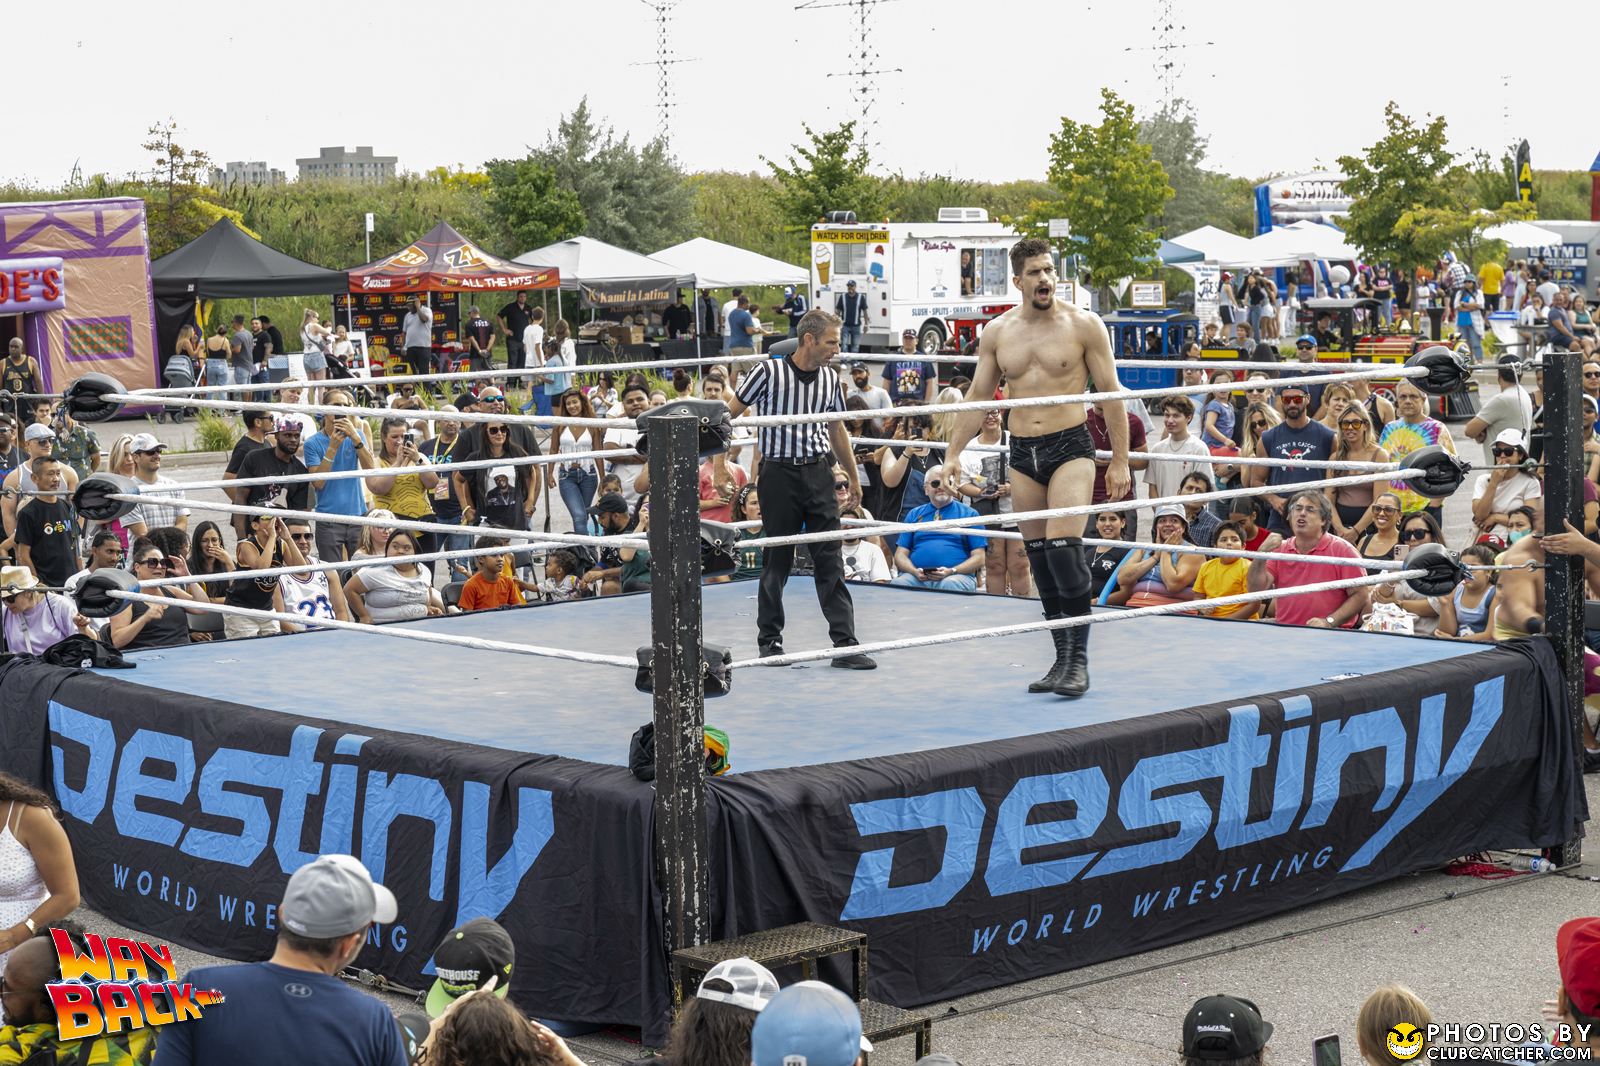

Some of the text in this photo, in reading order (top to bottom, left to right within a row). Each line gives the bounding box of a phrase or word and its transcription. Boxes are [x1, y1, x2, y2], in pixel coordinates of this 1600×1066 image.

[816, 232, 838, 240] WATCH
[856, 232, 887, 241] CHILDREN
[1543, 245, 1574, 258] ATM
[461, 278, 484, 287] ALL
[484, 277, 508, 287] THE
[509, 275, 533, 286] HITS
[971, 845, 1335, 955] WORLD WRESTLING
[113, 862, 409, 953] WORLD WRENG
